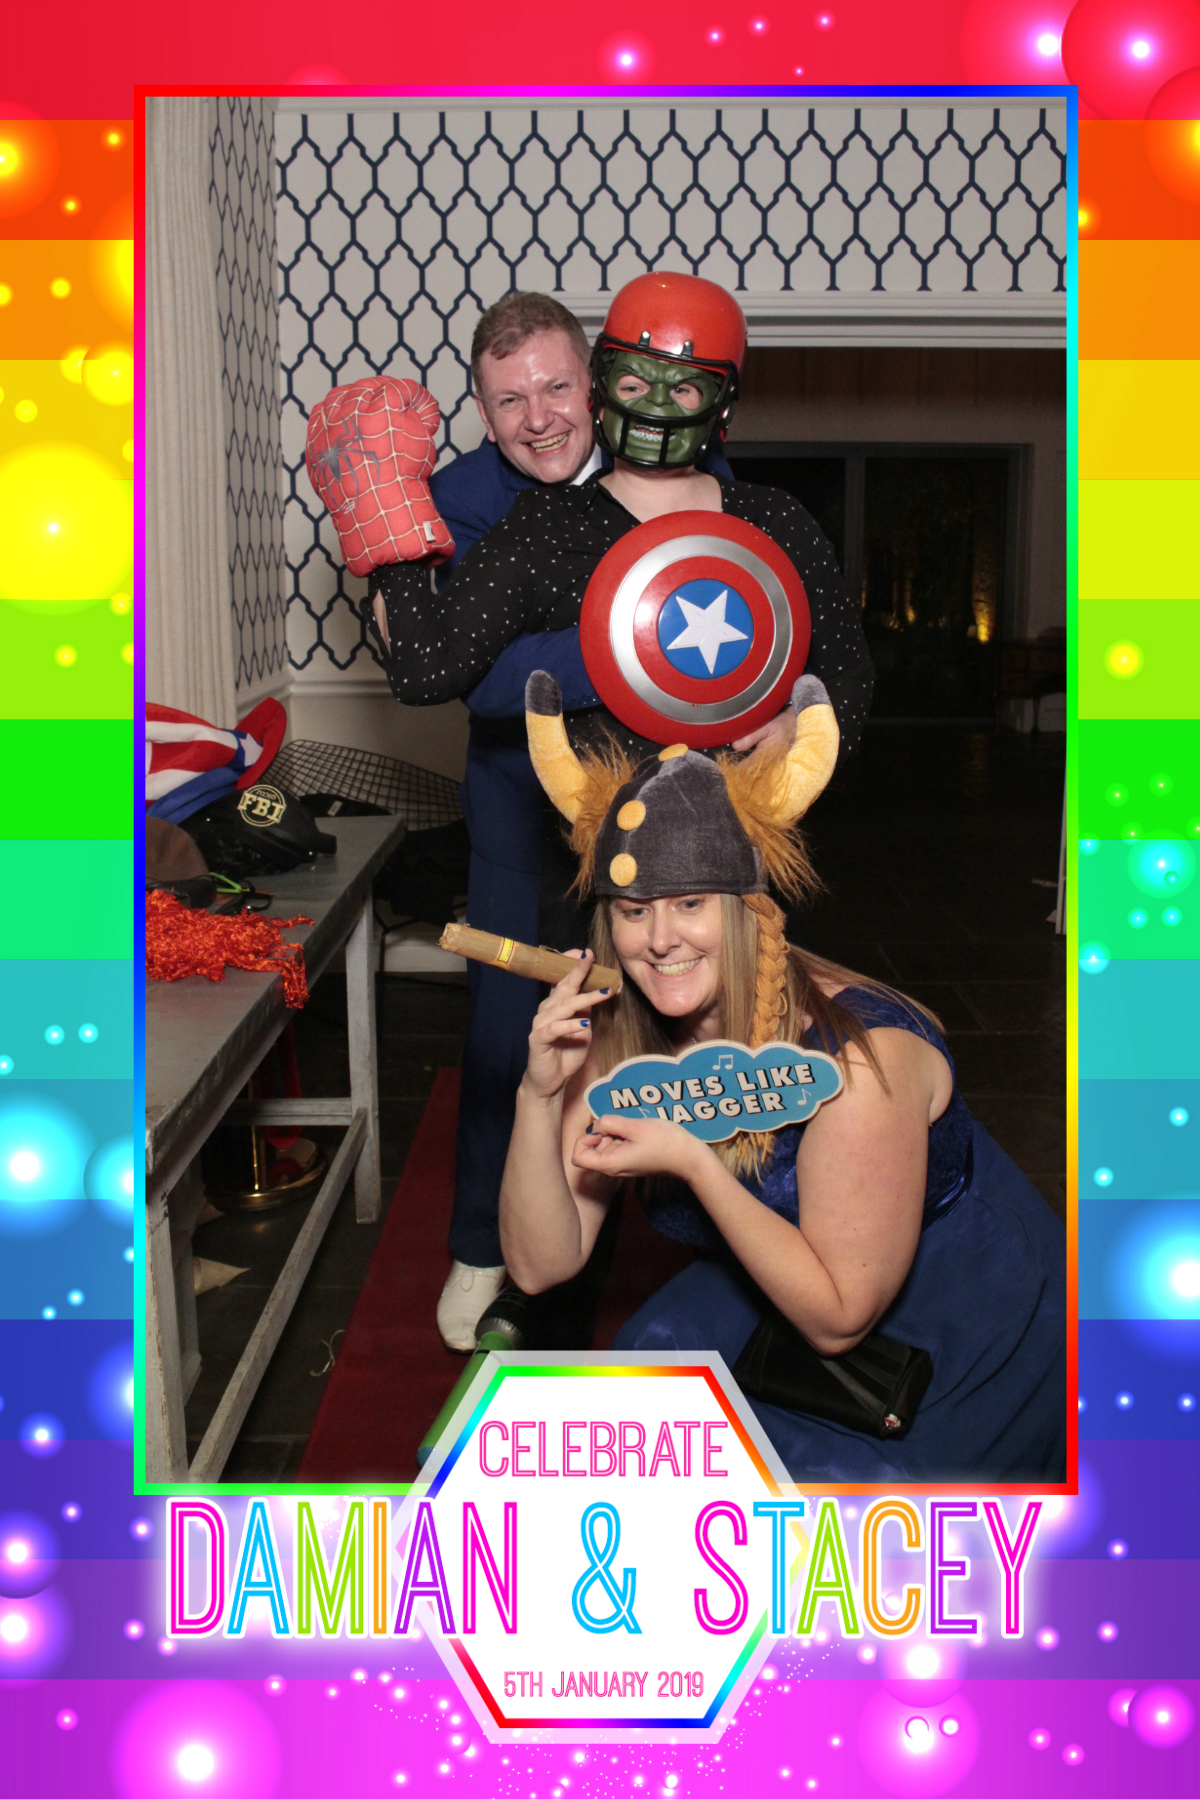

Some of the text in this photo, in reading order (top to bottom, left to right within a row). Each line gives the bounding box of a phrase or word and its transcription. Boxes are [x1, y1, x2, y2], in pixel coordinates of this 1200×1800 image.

[237, 791, 287, 824] FBI
[609, 1063, 816, 1109] MOVES LIKE
